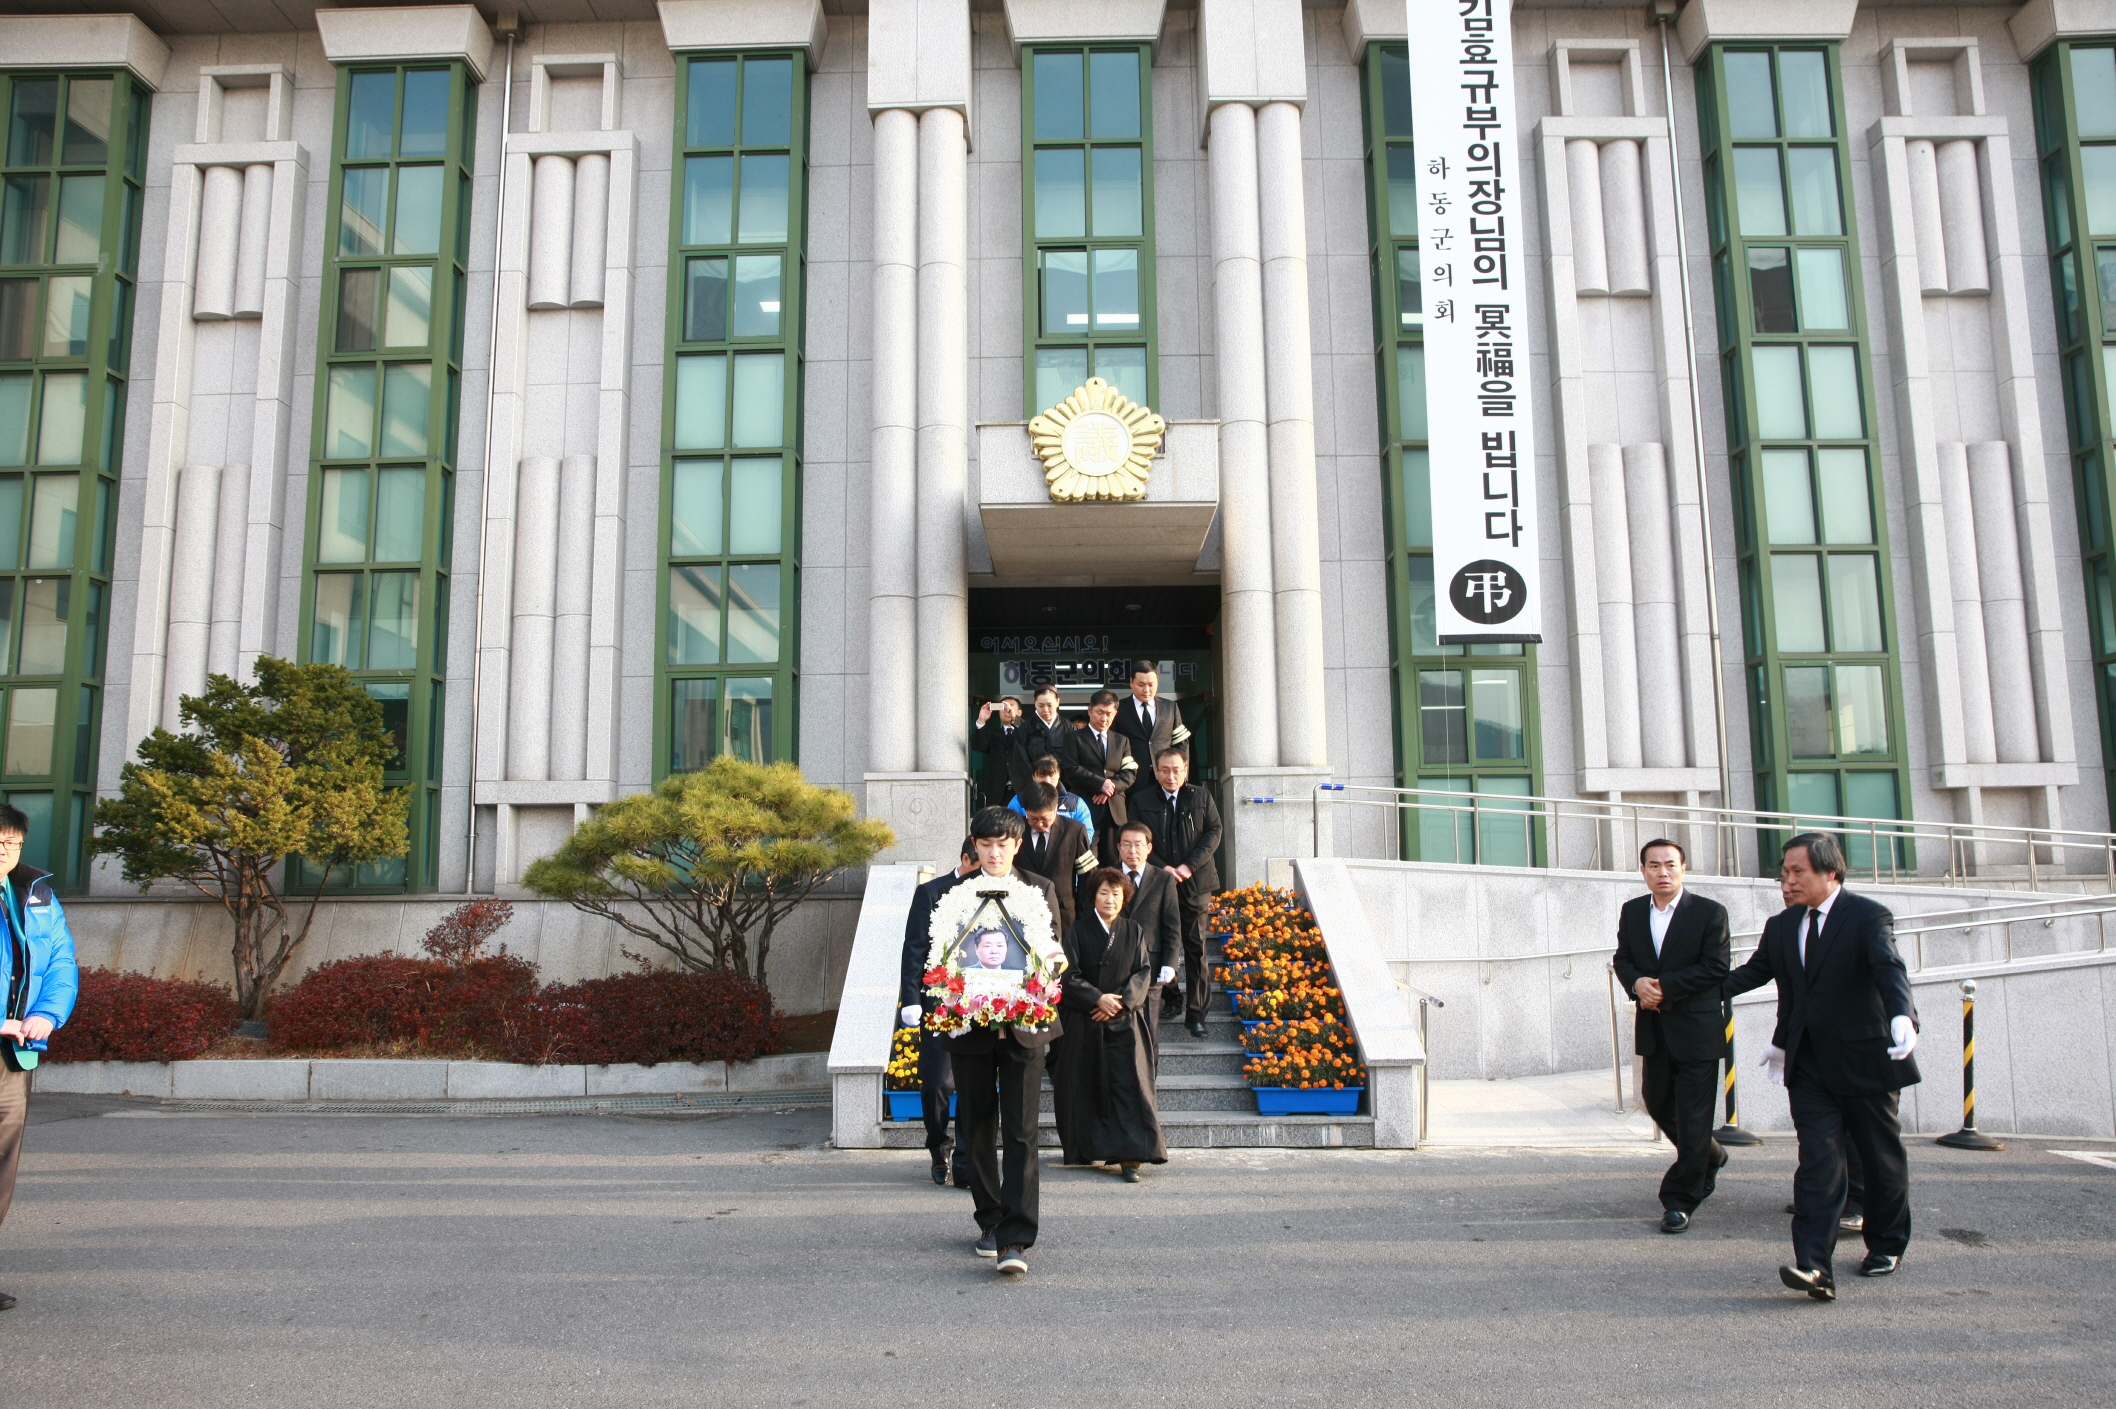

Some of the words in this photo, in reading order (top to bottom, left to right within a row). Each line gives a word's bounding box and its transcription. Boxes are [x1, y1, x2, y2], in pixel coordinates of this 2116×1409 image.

[1459, 0, 1511, 290] 김효규부의장님의
[1427, 156, 1455, 324] 하동군의회
[1475, 304, 1516, 416] 冥福을
[1482, 431, 1522, 547] 빕니다
[981, 634, 1109, 654] 어서오십시오!
[1464, 566, 1512, 613] 弔
[1003, 659, 1131, 687] 하동군의회
